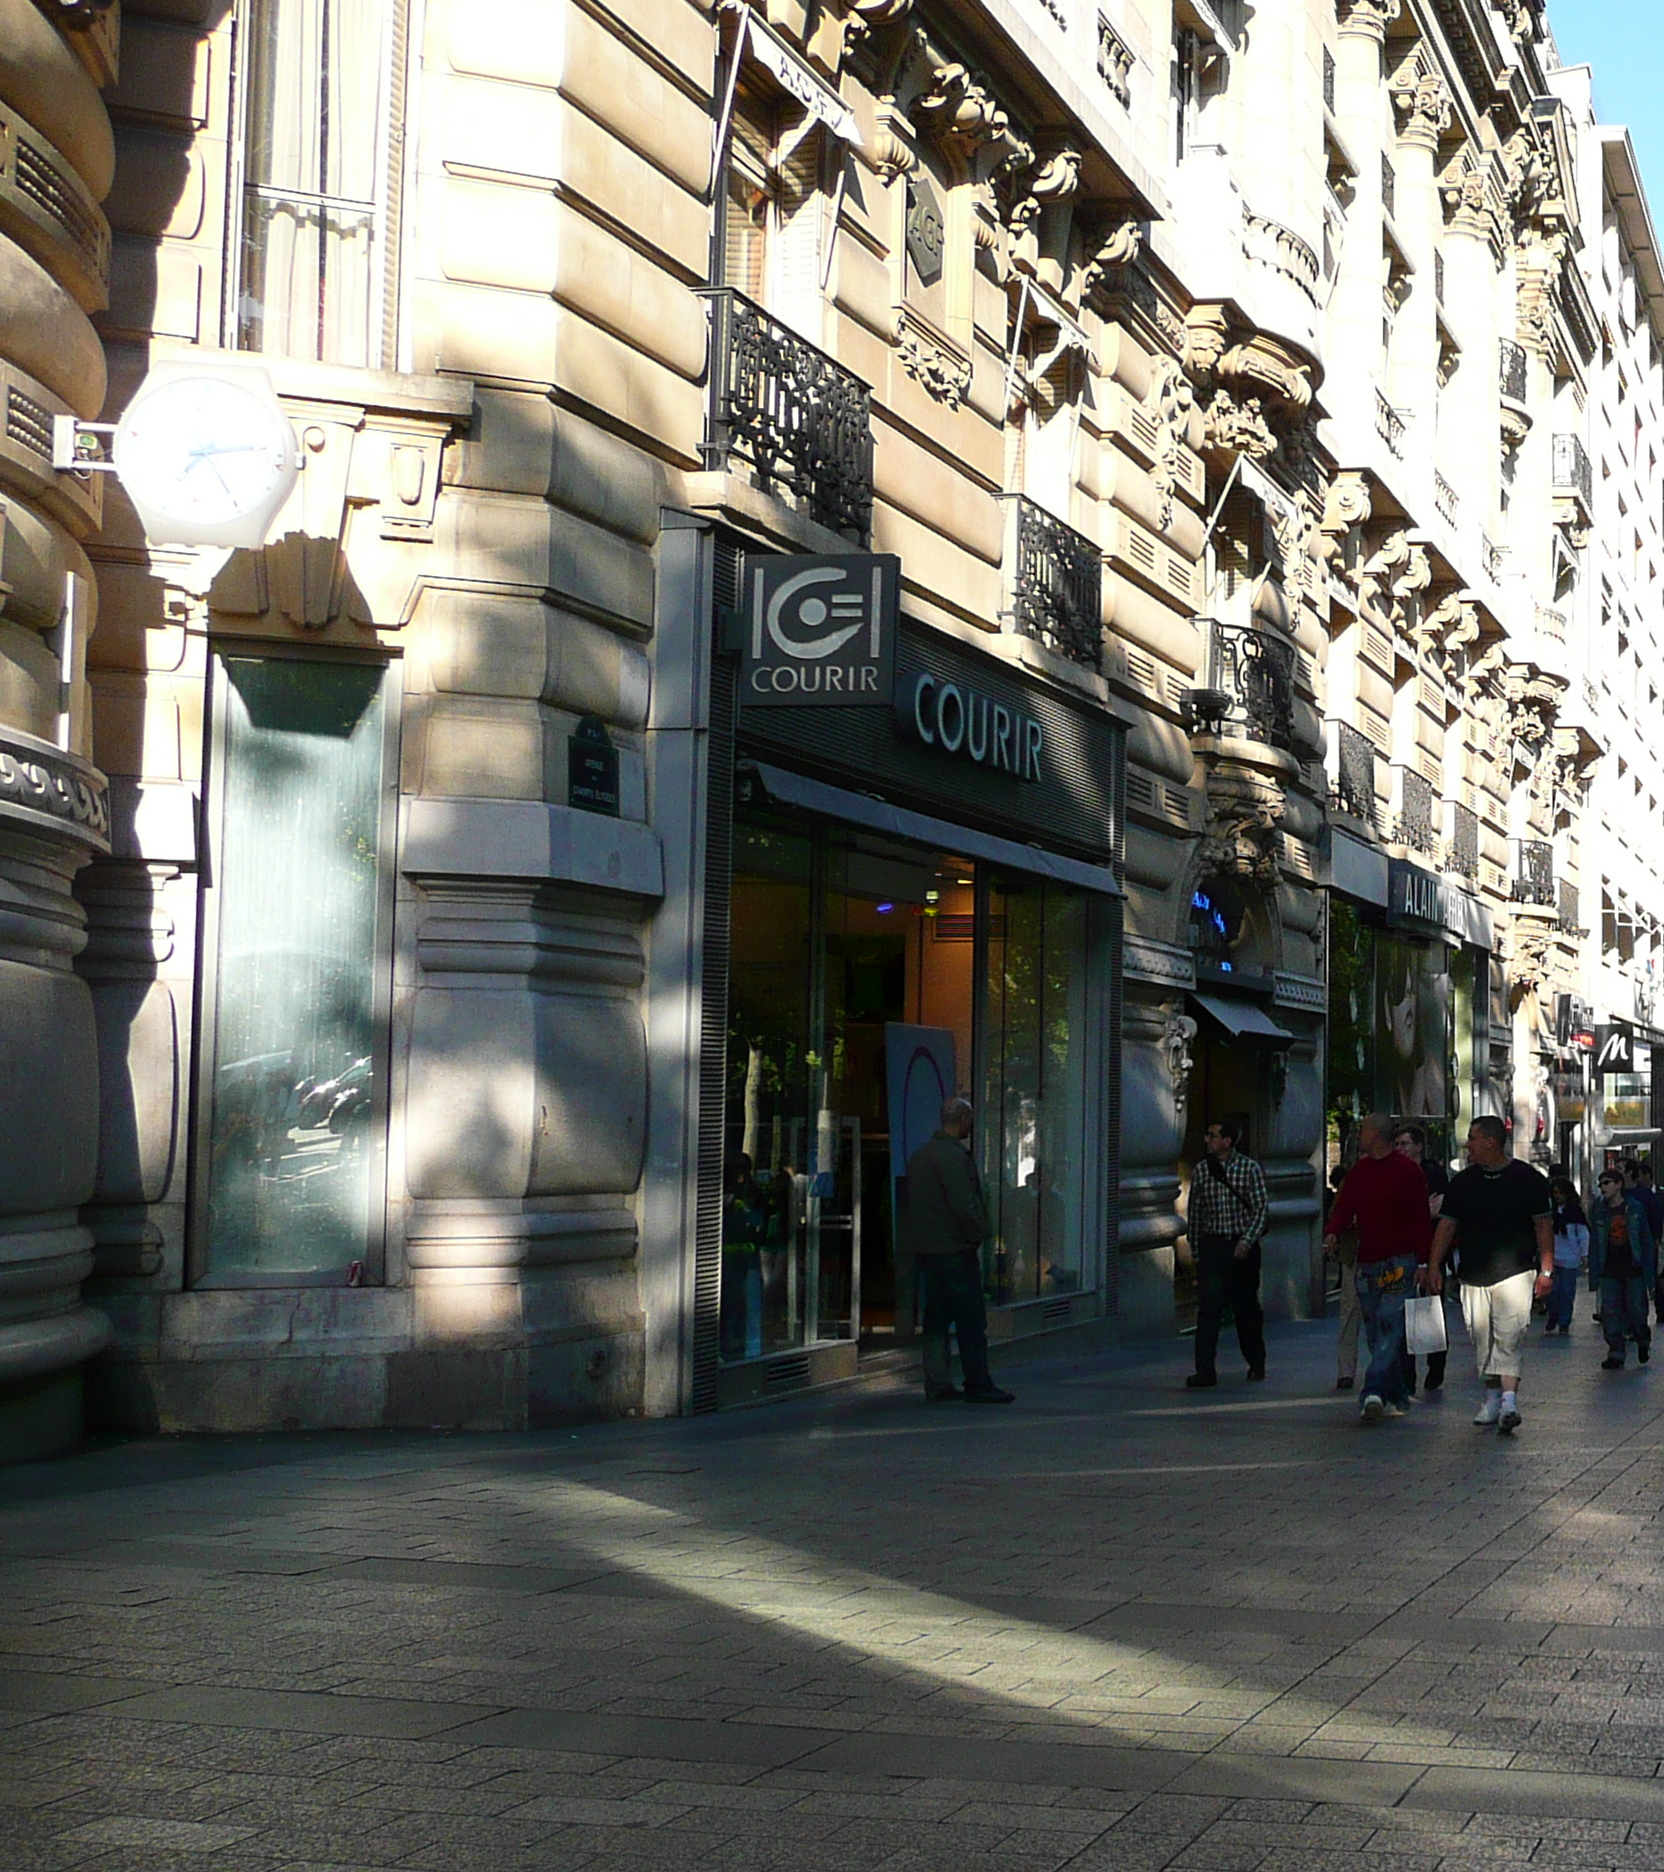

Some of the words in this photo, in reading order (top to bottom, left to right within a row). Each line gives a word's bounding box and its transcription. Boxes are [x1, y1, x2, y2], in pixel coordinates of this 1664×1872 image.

[752, 666, 879, 692] COURIR
[915, 673, 1043, 782] COURIR
[1405, 873, 1438, 922] ALAIN
[1597, 1033, 1629, 1066] M
